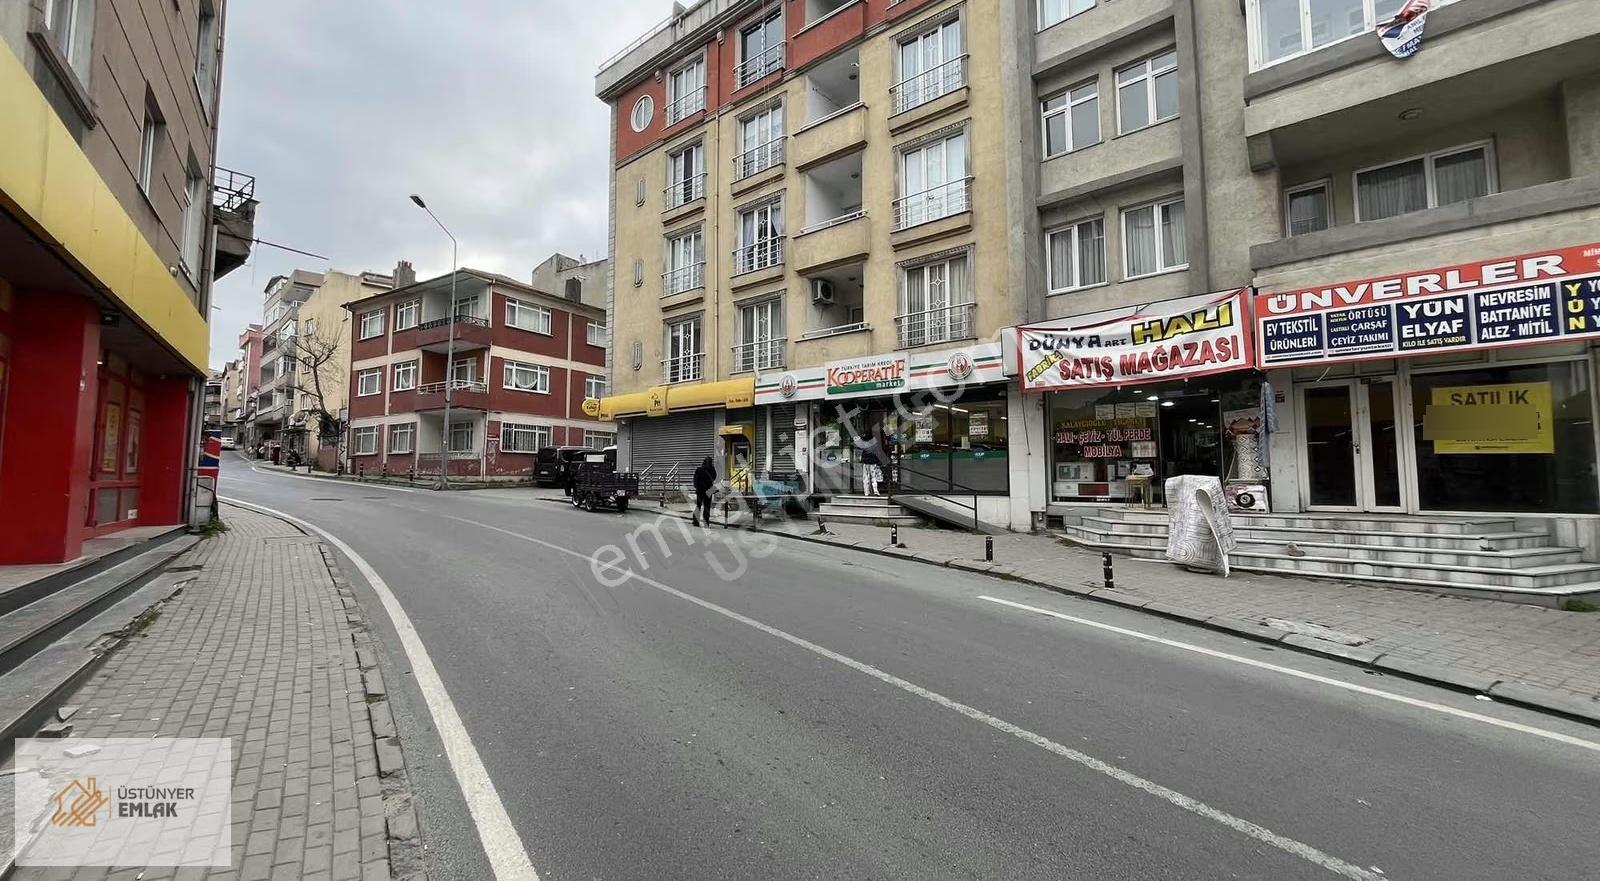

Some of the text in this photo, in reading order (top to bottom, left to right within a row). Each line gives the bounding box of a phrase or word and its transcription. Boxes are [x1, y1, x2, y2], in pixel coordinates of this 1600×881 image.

[1267, 254, 1568, 314] ÜNVERLER
[1479, 285, 1551, 307] NEVRESİM
[1347, 306, 1387, 320] ÖRTÜSÜ
[1402, 298, 1465, 319] YÜN
[1480, 303, 1552, 324] BATTANİYE
[1029, 333, 1102, 351] DÜNYA
[1130, 301, 1234, 346] HALI
[1266, 317, 1319, 337] EV TEKSTİL
[1351, 320, 1388, 333] ÇARŞAF
[1402, 319, 1464, 339] ELYAF
[1481, 325, 1511, 341] ALEZ
[1518, 319, 1554, 336] MİTİL
[1270, 334, 1317, 351] ÜRÜNLERİ
[1331, 332, 1389, 348] ÇEYİZ TAKIMI
[1059, 356, 1115, 381] SATIŞ
[1119, 335, 1240, 376] MAĞAZASI
[827, 360, 905, 388] KOOPERATİF
[875, 379, 901, 389] market
[1106, 427, 1123, 442] TÜL
[1123, 428, 1151, 441] PERDE
[1083, 443, 1123, 458] MOBİLYA
